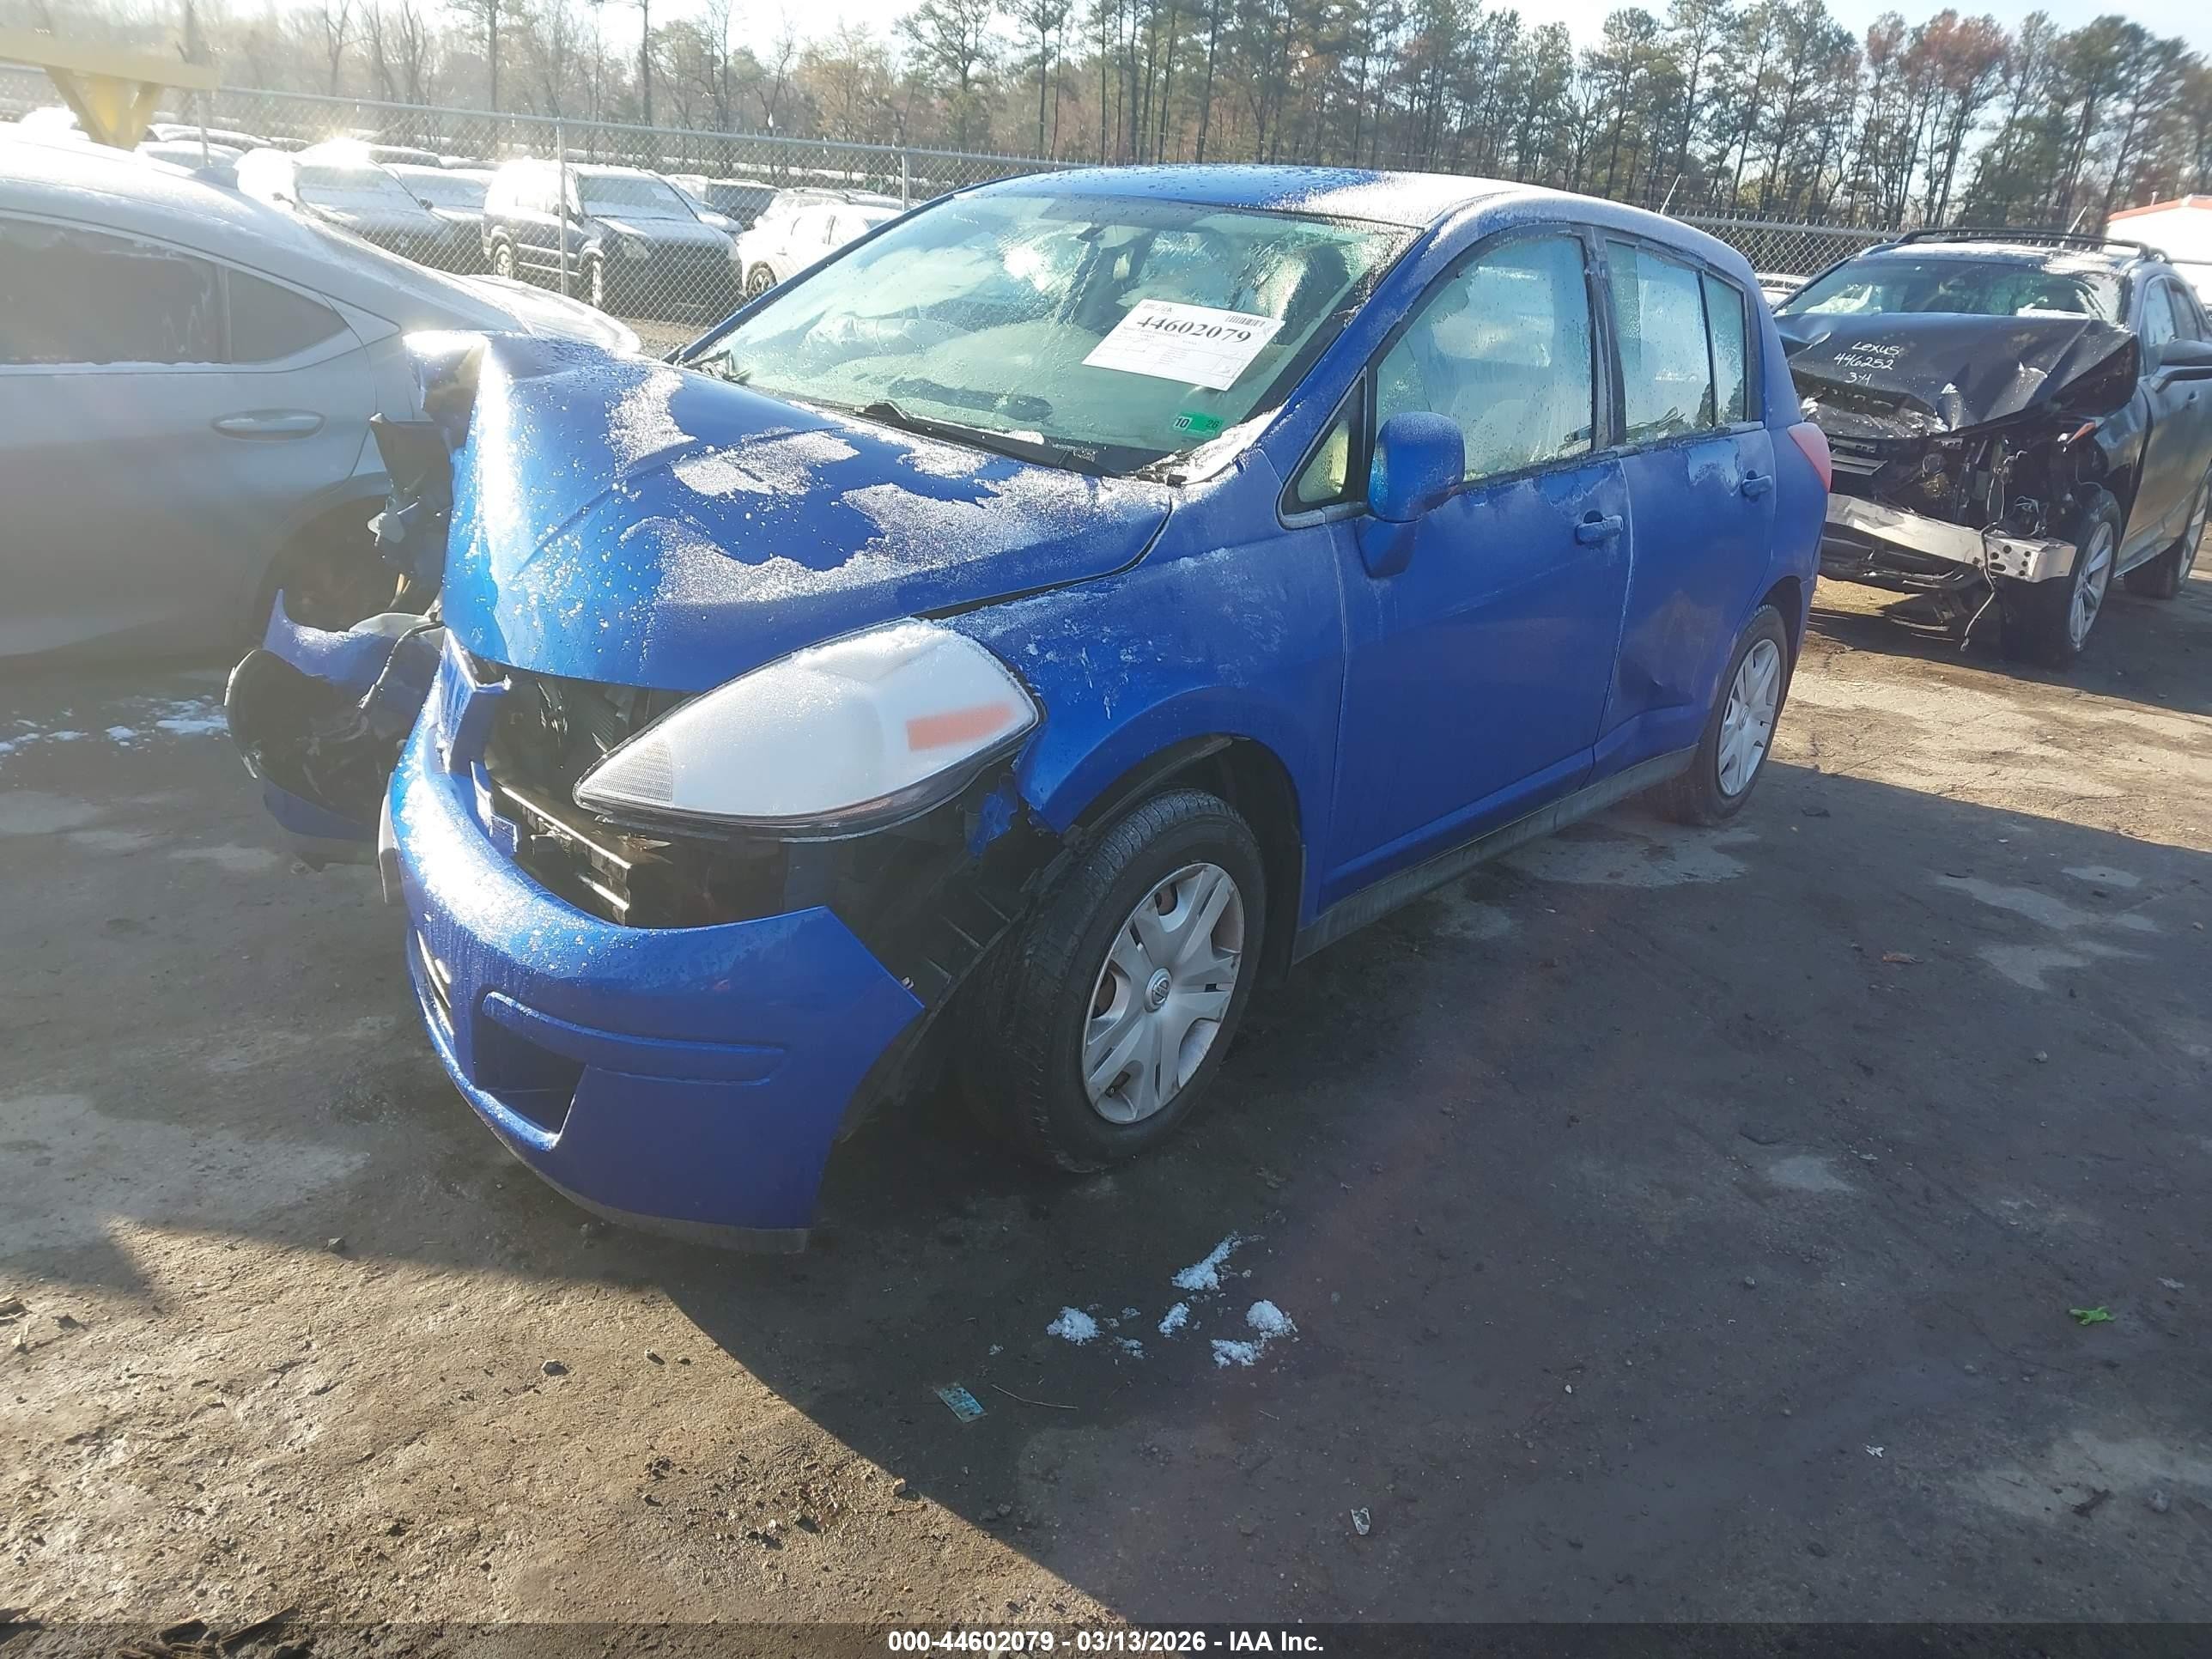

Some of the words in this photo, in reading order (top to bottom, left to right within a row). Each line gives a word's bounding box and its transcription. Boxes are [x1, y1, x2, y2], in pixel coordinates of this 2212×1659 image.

[1137, 315, 1252, 343] 44602079
[1833, 352, 1894, 370] 446252
[1175, 416, 1190, 428] 10
